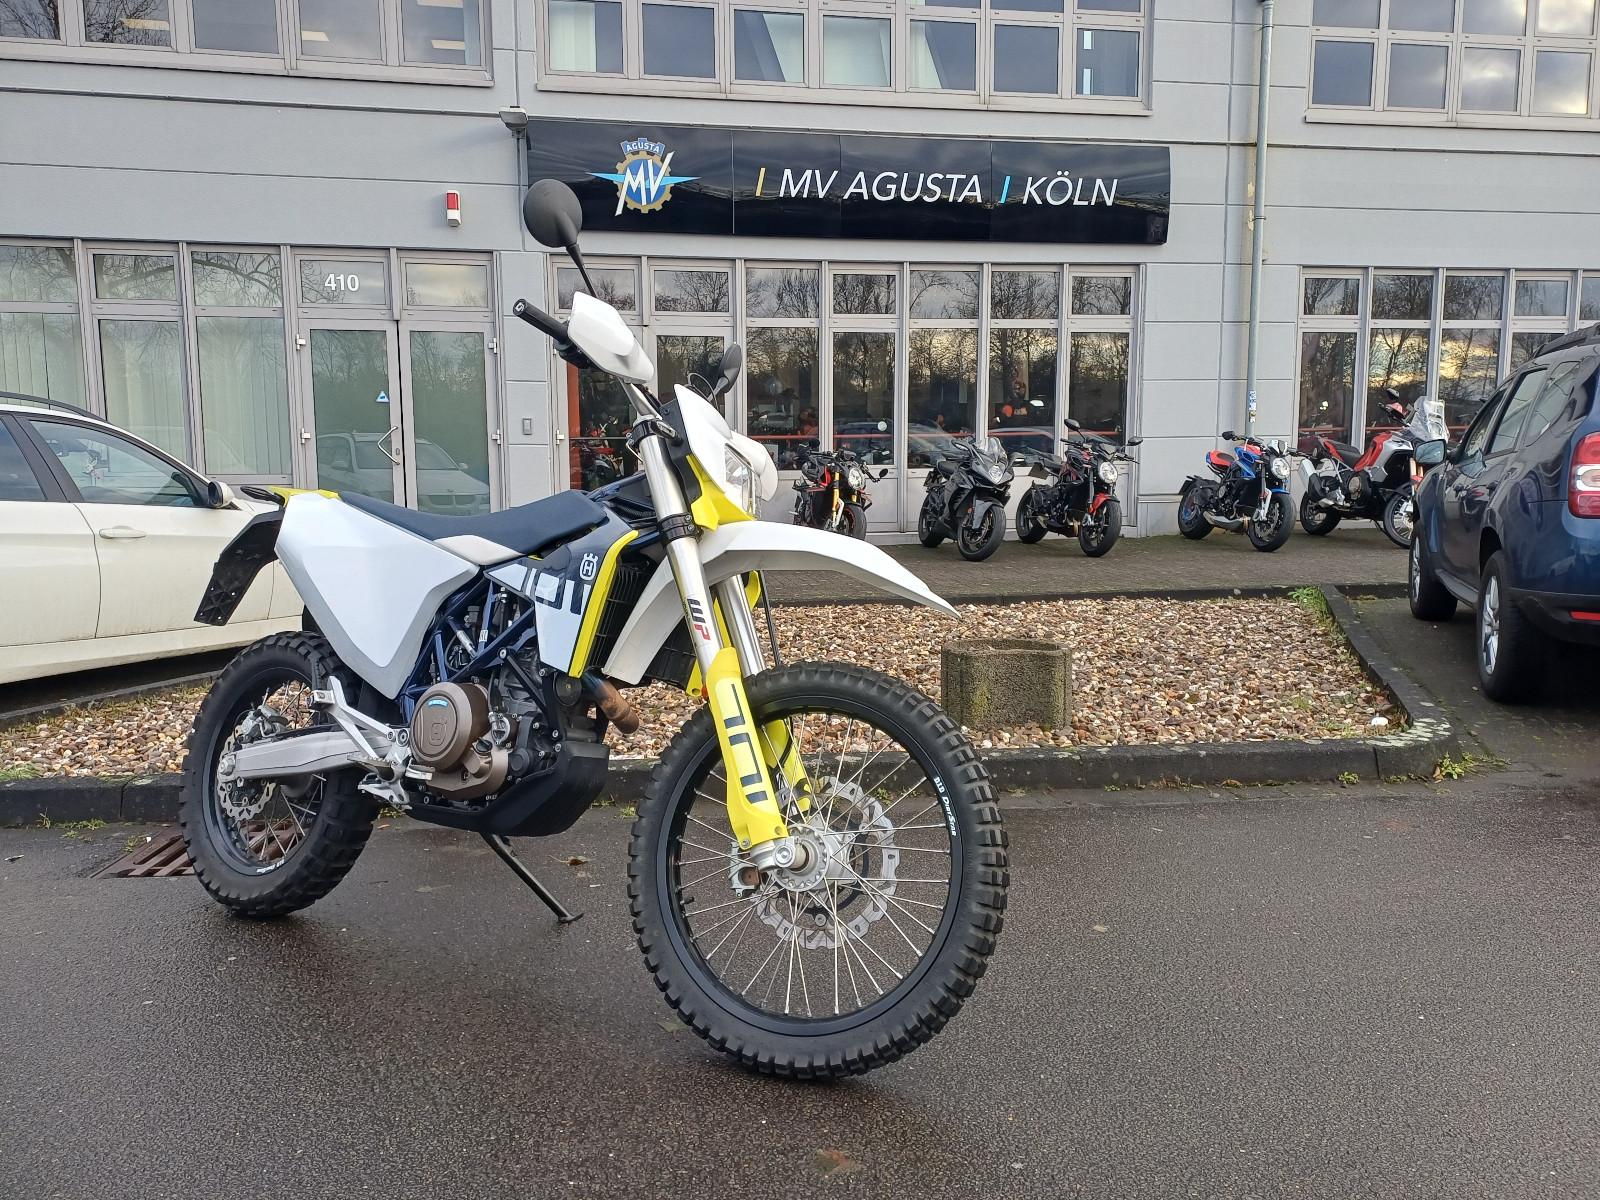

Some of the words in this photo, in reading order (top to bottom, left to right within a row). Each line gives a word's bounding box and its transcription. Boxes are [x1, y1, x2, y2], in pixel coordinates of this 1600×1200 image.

[626, 142, 660, 153] AGUSTA
[615, 151, 675, 216] MV
[779, 168, 839, 198] MV
[842, 171, 983, 203] AGUSTA
[1022, 170, 1118, 206] KÖLN
[324, 273, 360, 292] 410
[687, 598, 711, 641] WP
